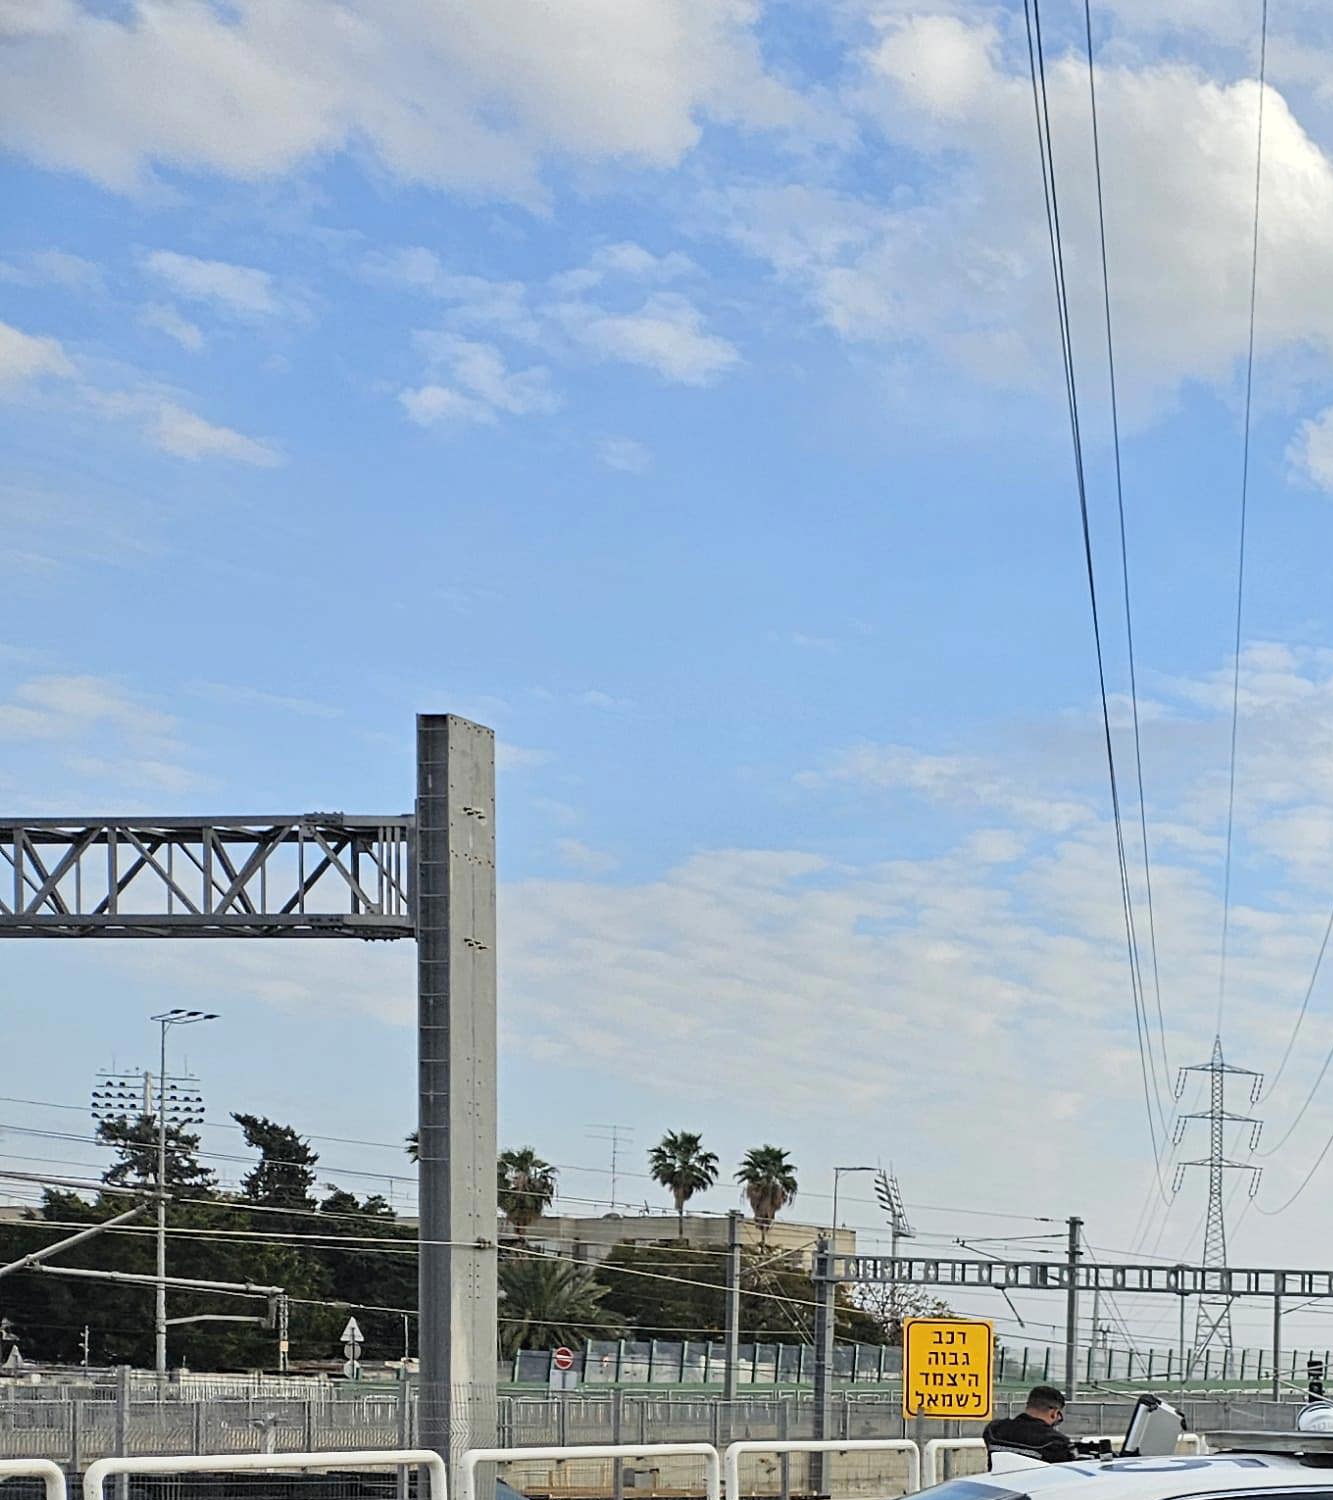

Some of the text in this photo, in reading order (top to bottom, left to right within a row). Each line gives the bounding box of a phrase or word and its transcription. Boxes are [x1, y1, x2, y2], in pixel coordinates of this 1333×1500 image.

[931, 1331, 966, 1345] רכב
[928, 1352, 970, 1366] גבוה
[920, 1372, 979, 1387] היצמד
[915, 1391, 982, 1407] לשמאל
